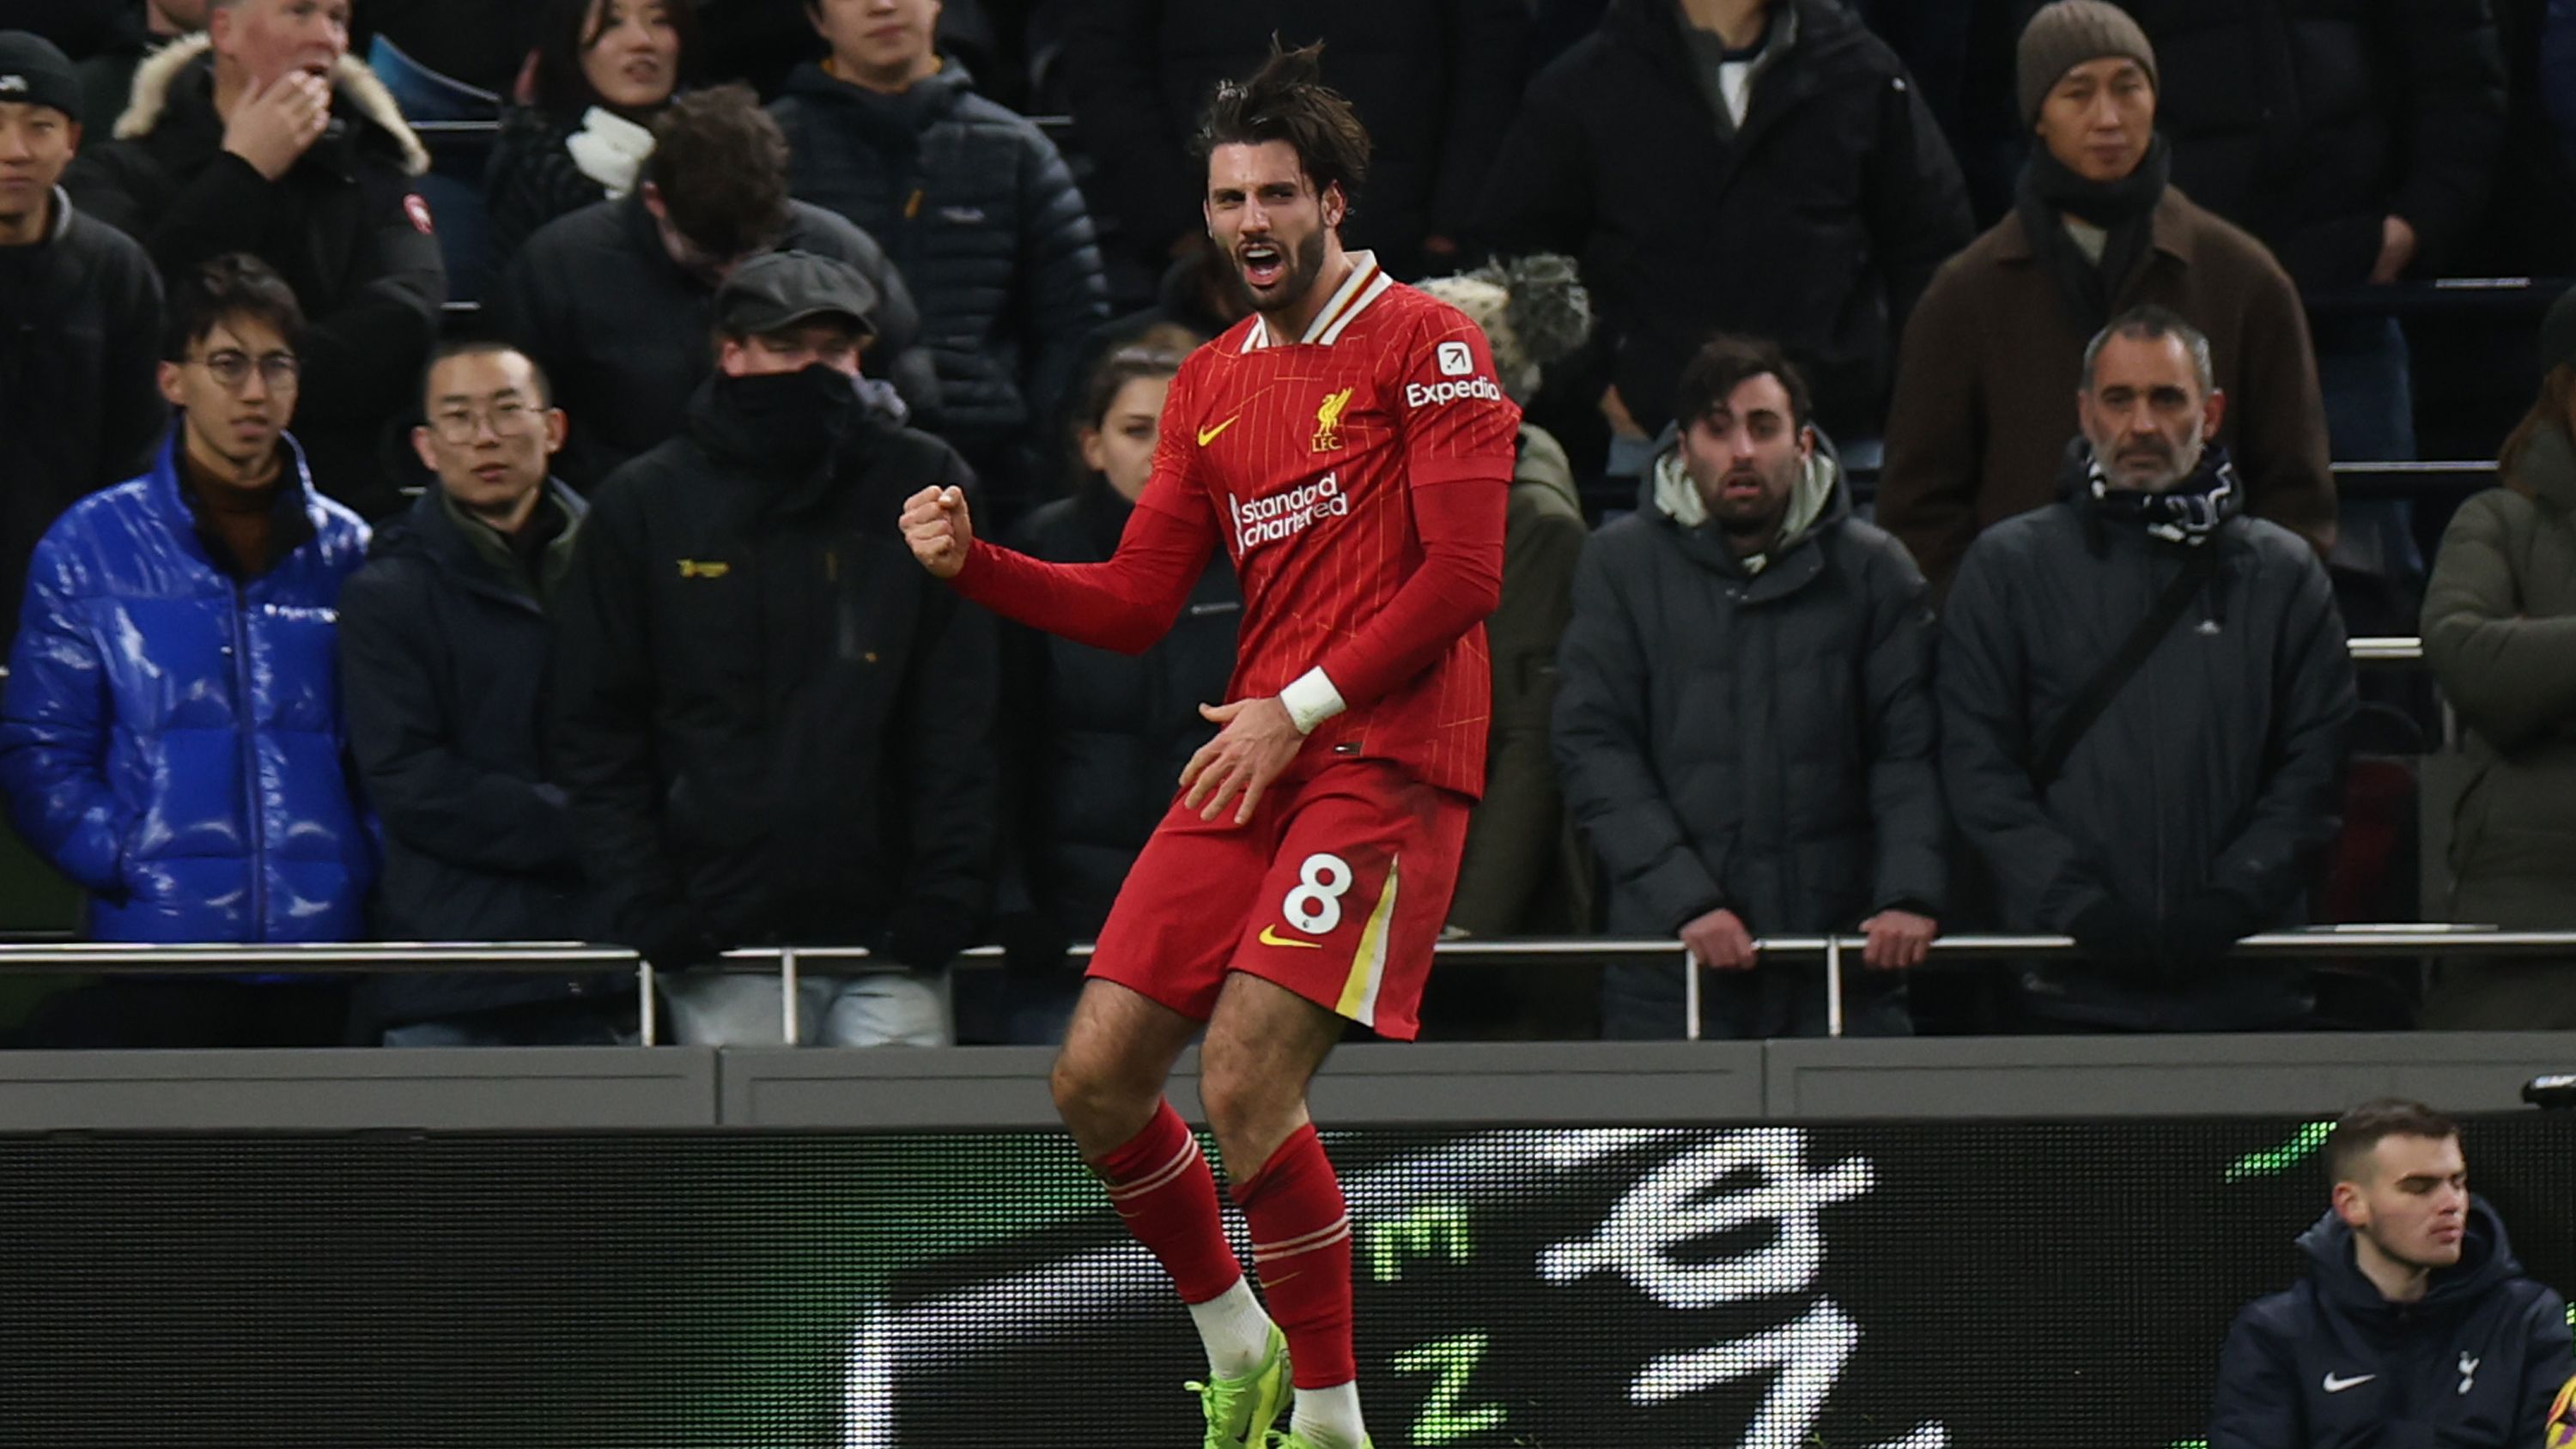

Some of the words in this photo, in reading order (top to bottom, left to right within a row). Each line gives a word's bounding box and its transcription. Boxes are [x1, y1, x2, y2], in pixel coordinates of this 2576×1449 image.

[1406, 378, 1501, 407] Expedia
[1242, 472, 1338, 524] standad
[1283, 852, 1352, 935] 8
